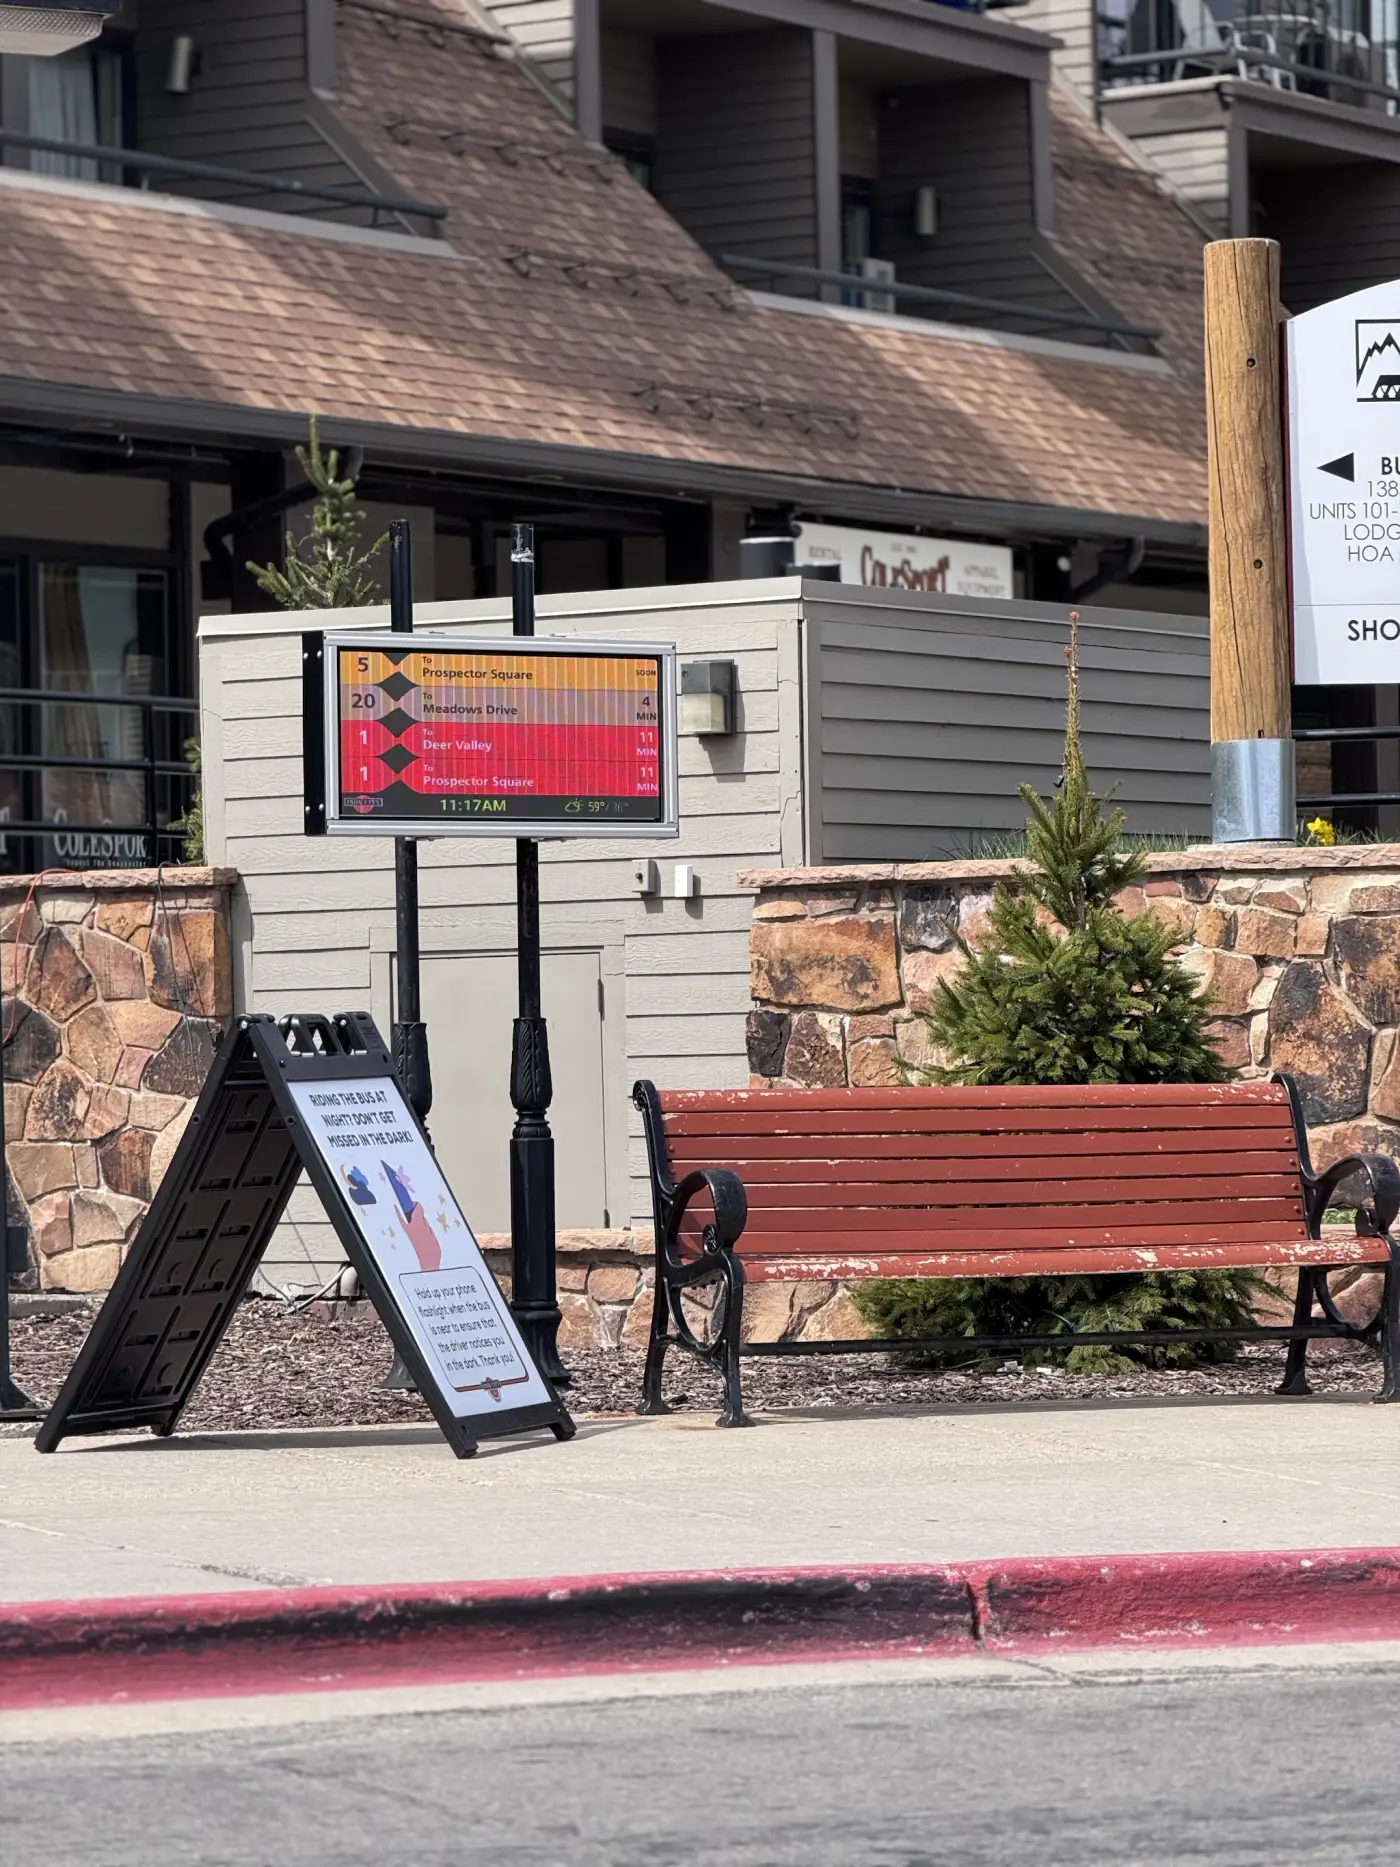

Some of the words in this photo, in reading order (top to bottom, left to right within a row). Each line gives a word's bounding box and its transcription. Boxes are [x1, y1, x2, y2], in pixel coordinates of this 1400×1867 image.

[1367, 480, 1400, 498] 138
[1309, 502, 1357, 520] UNITS
[1344, 523, 1400, 541] LODG
[1348, 545, 1394, 562] HOA
[1347, 619, 1400, 642] SHO
[358, 657, 369, 673] 5
[422, 656, 432, 664] To
[422, 667, 488, 680] Prospector
[491, 669, 533, 681] Square
[351, 693, 376, 709] 20
[422, 692, 433, 700] To
[641, 696, 651, 707] 4
[423, 703, 483, 714] Meadows
[486, 704, 518, 715] Drive
[636, 712, 657, 721] MIN
[359, 730, 368, 745] 1
[422, 728, 433, 736] To
[639, 731, 653, 743] 11
[423, 739, 453, 750] Deer
[455, 739, 492, 753] Valley
[636, 747, 657, 757] MIN
[359, 766, 368, 781] 1
[423, 764, 433, 772] To
[640, 767, 654, 778] 11
[423, 776, 489, 788] Prospector
[492, 776, 534, 789] Square
[636, 782, 658, 791] MIN
[440, 799, 507, 812] 11:17AM
[54, 808, 152, 858] COLESPOR
[308, 1093, 341, 1107] RIDING
[338, 1092, 359, 1106] THE
[356, 1091, 376, 1105] BUS
[375, 1090, 388, 1104] AT
[321, 1113, 354, 1127] NIGHT?
[353, 1112, 380, 1126] DON'T
[378, 1110, 397, 1124] GET
[327, 1134, 360, 1148] MISSED
[358, 1133, 371, 1147] IN
[368, 1132, 388, 1146] THE
[385, 1131, 414, 1145] DARK!
[414, 1287, 430, 1300] Hold
[430, 1289, 442, 1301] up
[440, 1287, 456, 1300] your
[455, 1284, 477, 1298] phone
[447, 1302, 467, 1315] when
[465, 1300, 479, 1312] the
[476, 1299, 491, 1311] bus
[436, 1323, 452, 1335] near
[451, 1322, 461, 1333] to
[459, 1320, 482, 1332] ensure
[480, 1317, 498, 1329] that
[438, 1342, 451, 1353] the
[449, 1340, 469, 1352] driver
[469, 1337, 493, 1350] notices
[491, 1335, 506, 1349] you
[444, 1360, 453, 1372] in
[451, 1358, 465, 1371] the
[478, 1353, 501, 1367] Thank
